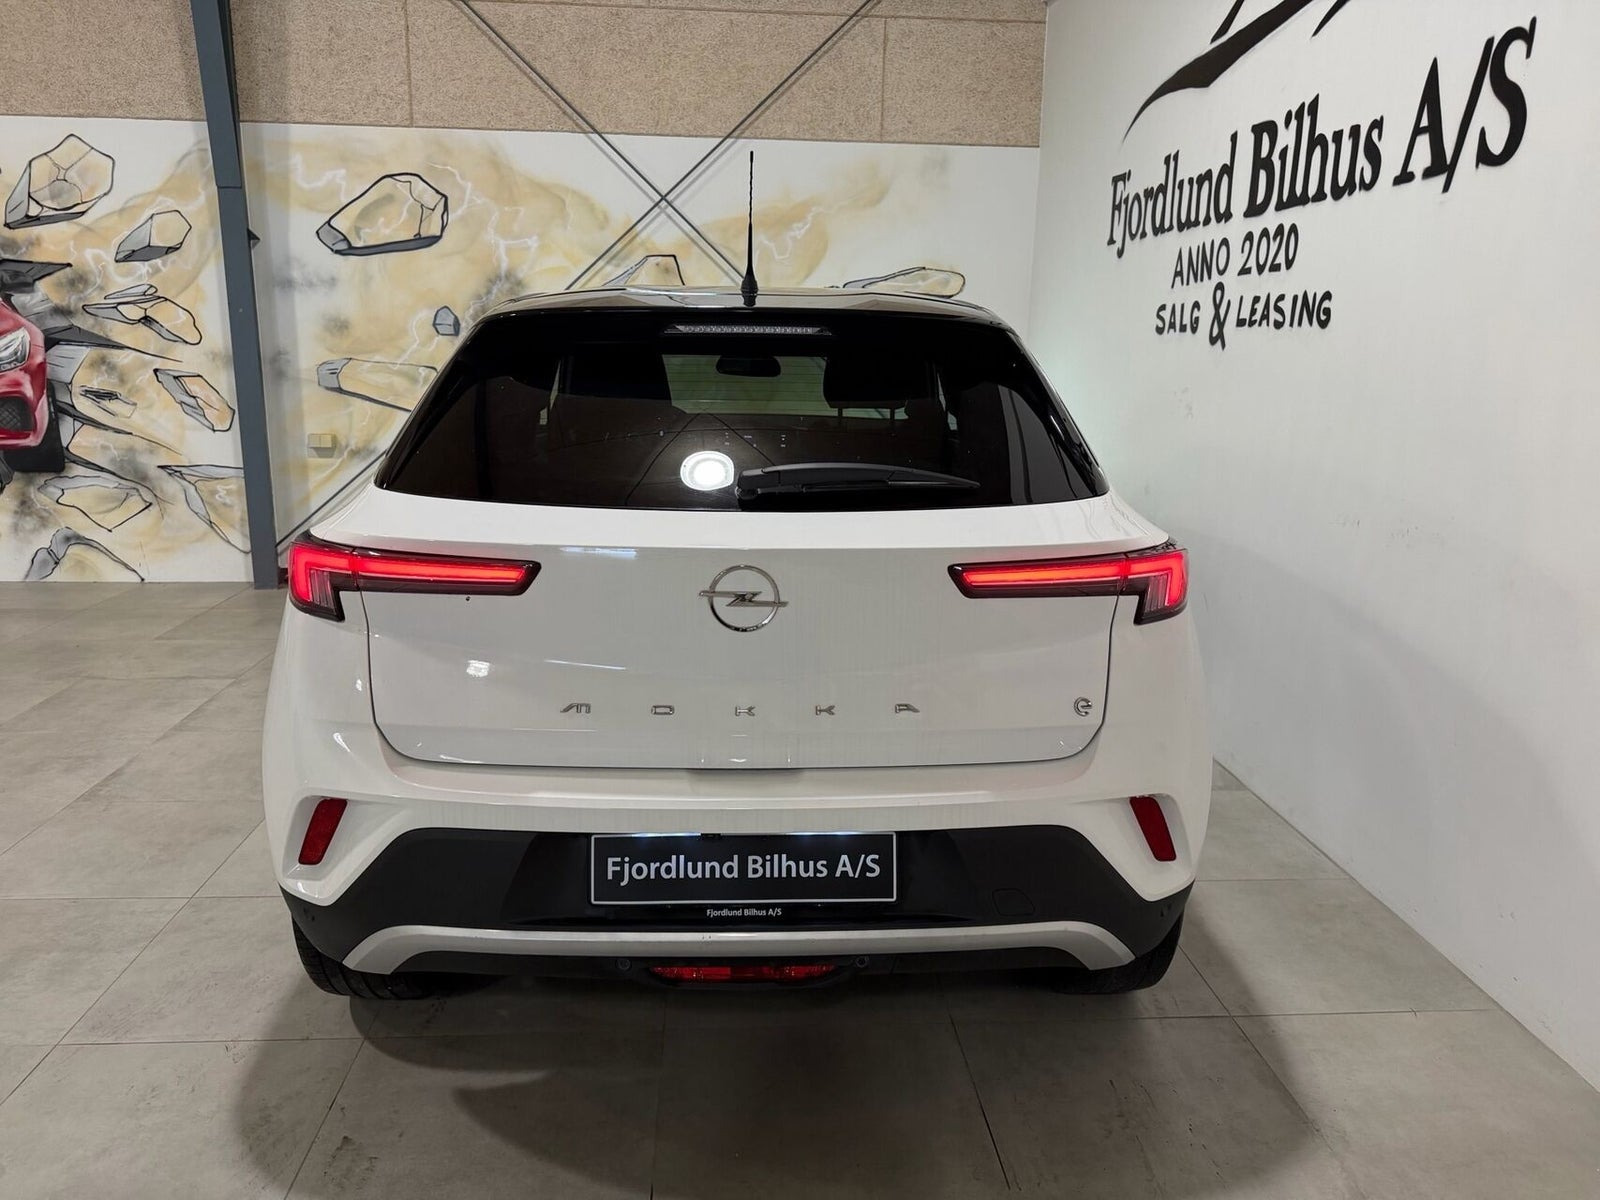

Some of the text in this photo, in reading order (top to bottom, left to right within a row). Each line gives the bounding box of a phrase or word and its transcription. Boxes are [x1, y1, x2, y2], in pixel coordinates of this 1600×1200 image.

[1107, 16, 1537, 258] Fjordlund Bilhus A/S
[1171, 222, 1299, 289] ANNO 2020
[1155, 281, 1333, 351] SALG & LEASING
[607, 853, 881, 887] Fjordlund Bilhus A/S
[706, 907, 782, 918] Fjordlund Bilhus A/S
